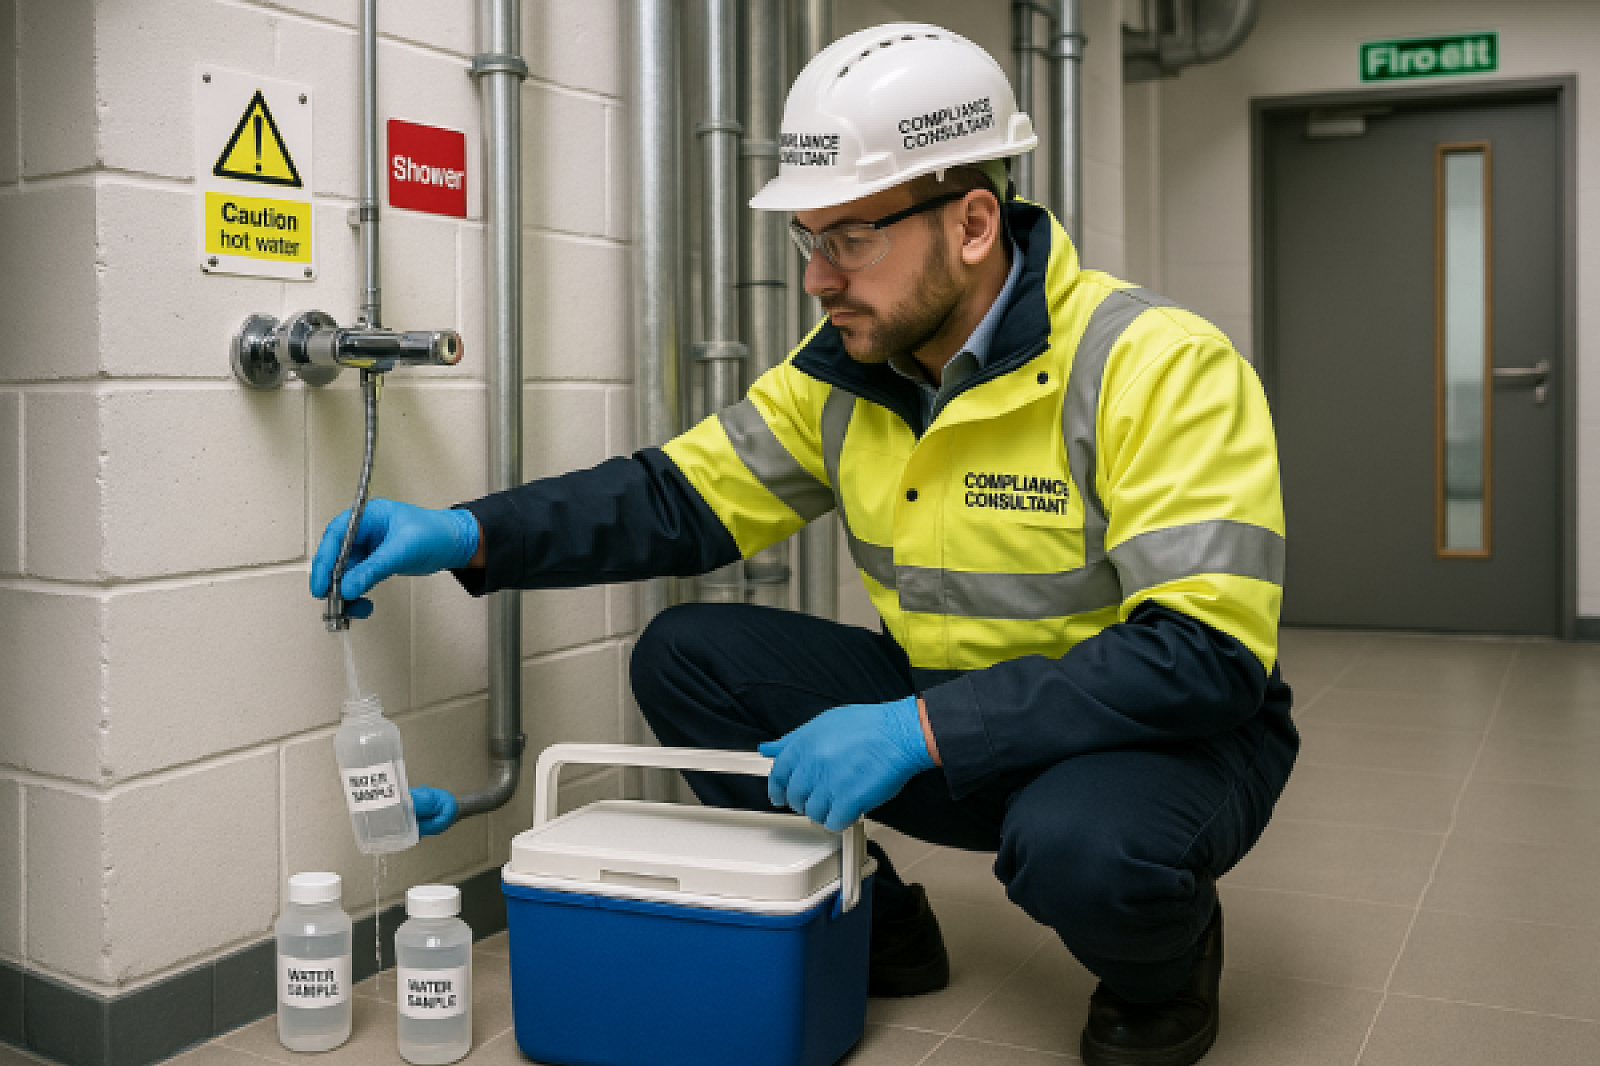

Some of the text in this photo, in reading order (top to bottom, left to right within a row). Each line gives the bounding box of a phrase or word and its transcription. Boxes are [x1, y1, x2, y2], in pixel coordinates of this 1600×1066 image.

[898, 96, 991, 135] COMPLIANCE
[903, 114, 996, 150] CONSULTANT
[392, 154, 465, 190] Shower
[220, 202, 298, 232] Caution
[220, 229, 301, 257] hot water
[964, 491, 1069, 516] CONSULTANT
[288, 967, 335, 983] WATER
[407, 978, 454, 994] WATER
[287, 982, 340, 999] SAMPLE
[407, 993, 457, 1009] SAMPLE
